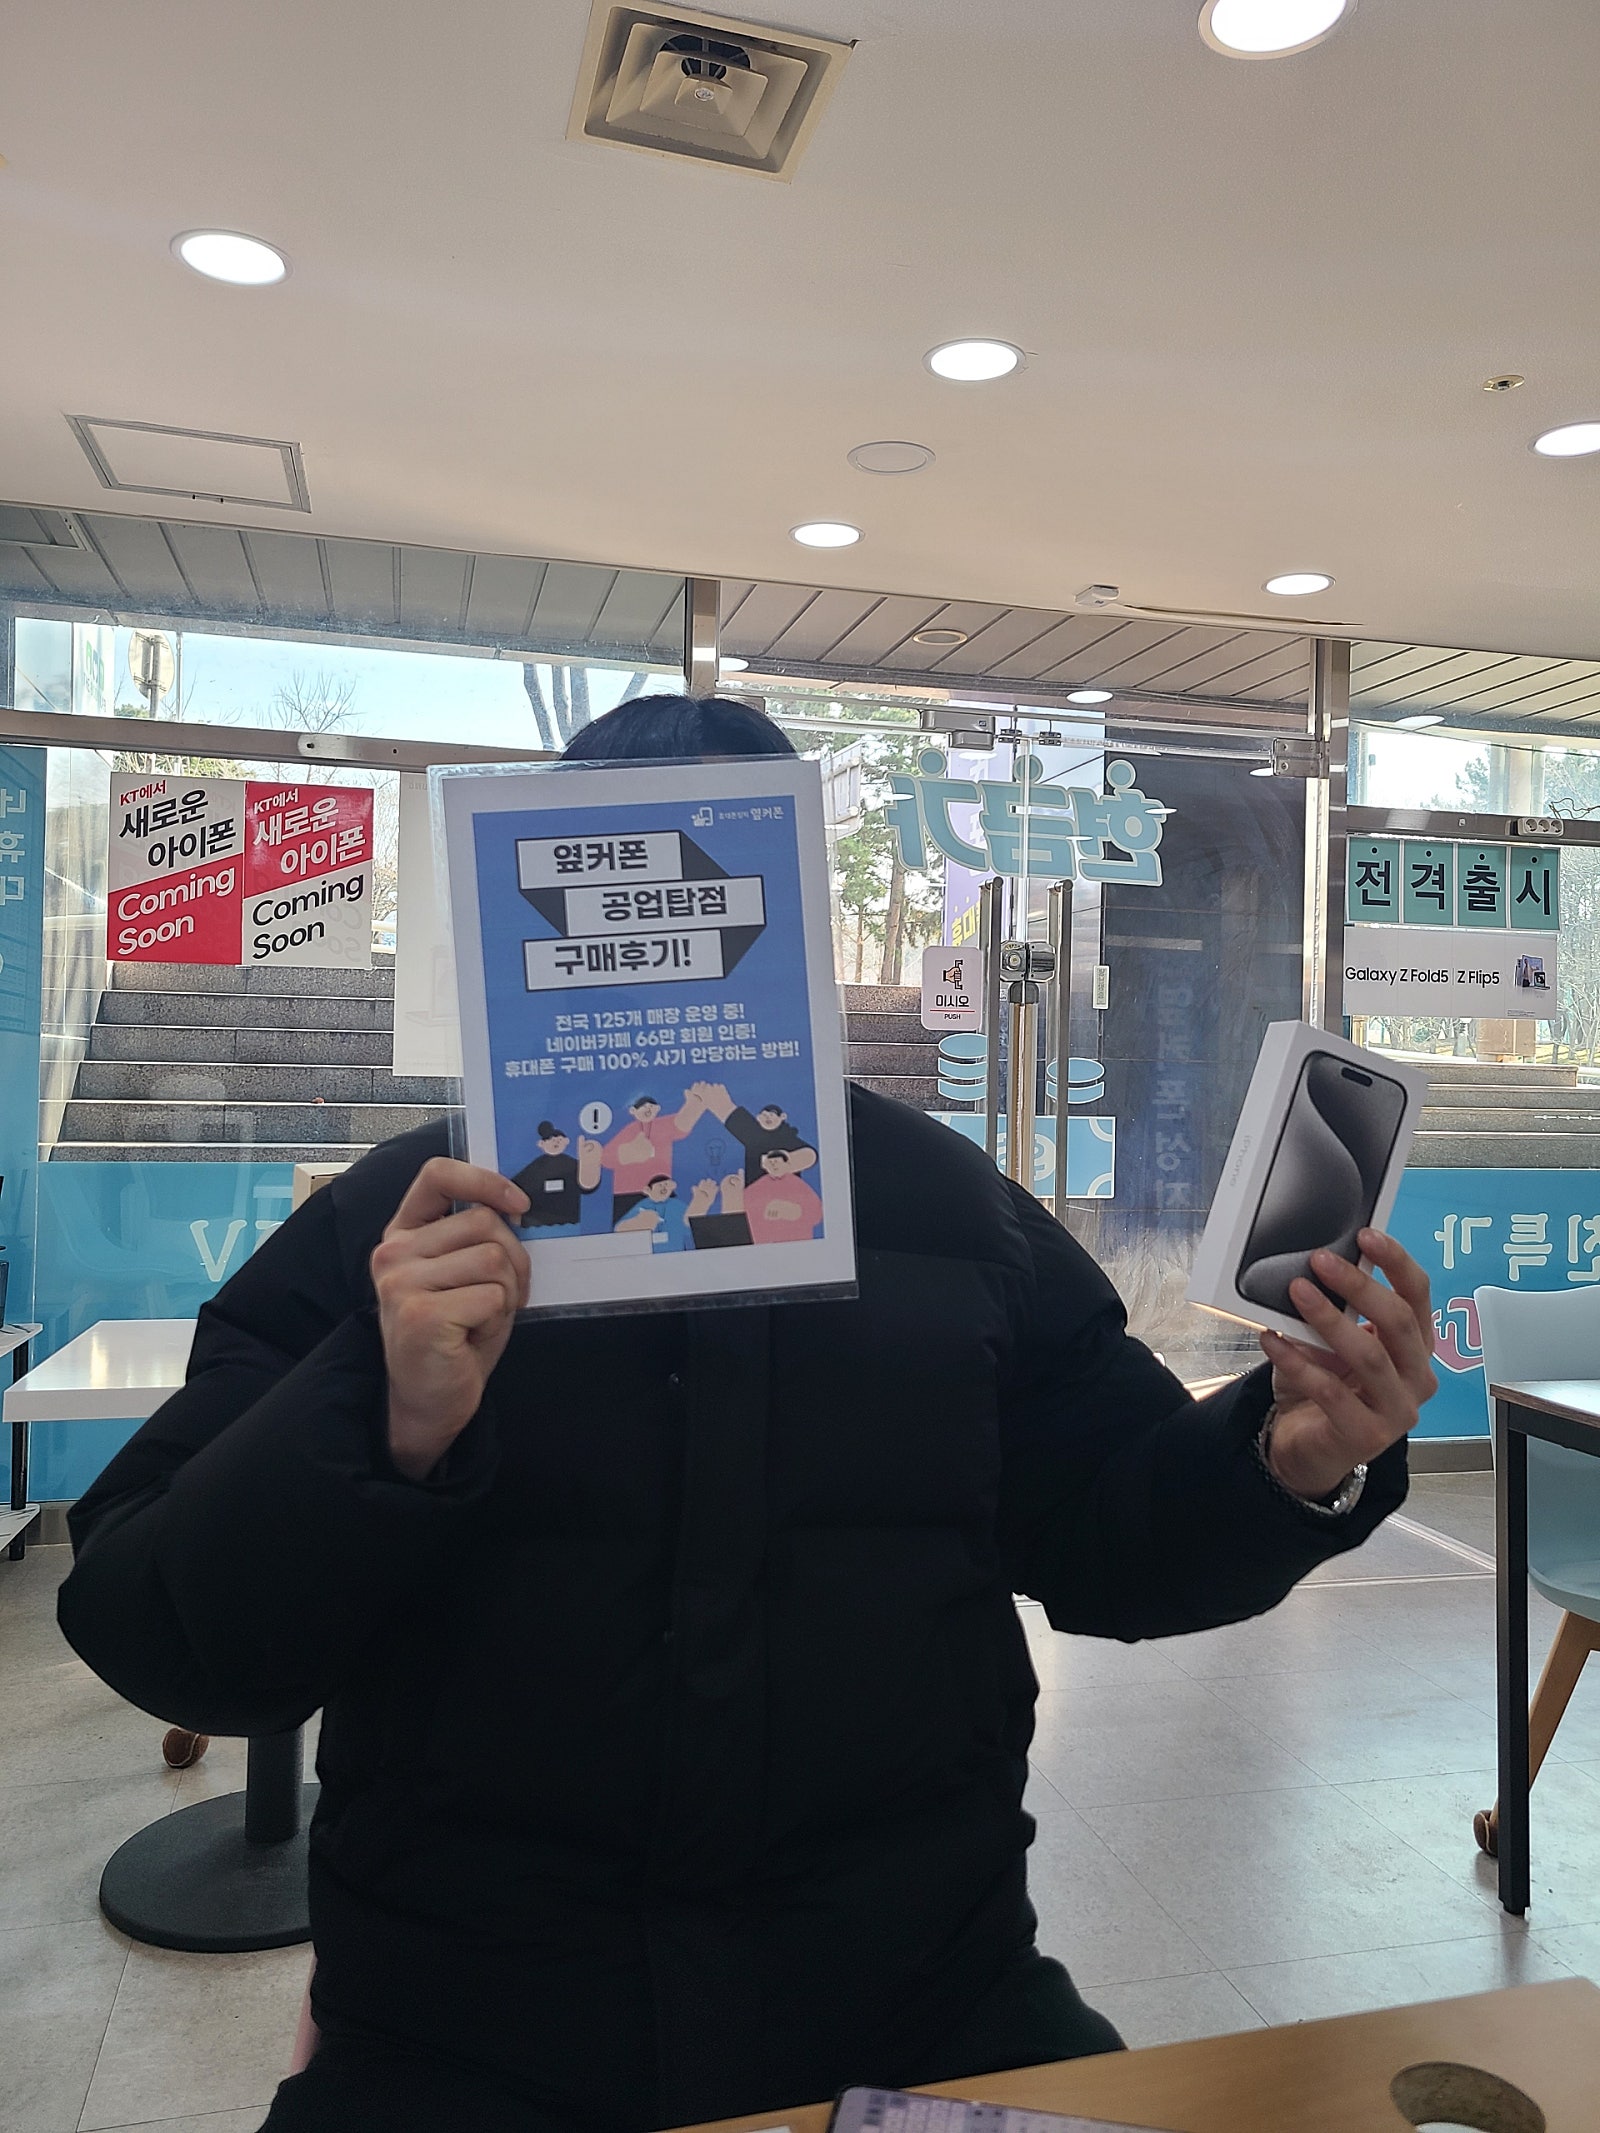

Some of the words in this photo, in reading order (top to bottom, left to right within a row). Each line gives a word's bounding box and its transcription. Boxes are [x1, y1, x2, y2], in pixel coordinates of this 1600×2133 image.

[119, 780, 167, 806] KT에서
[253, 788, 299, 815] KT에서
[118, 789, 209, 840] 새로운
[252, 797, 340, 848] 새로운
[750, 806, 784, 821] 옆커폰
[147, 818, 236, 869] 아이폰
[280, 825, 367, 876] 아이폰
[553, 840, 649, 875] 옆커폰
[117, 866, 236, 922] Coming
[252, 873, 365, 927] Coming
[601, 885, 728, 922] 공업탑점
[1354, 858, 1551, 916] 전격출시
[117, 912, 195, 956] Soon
[252, 918, 326, 960] Soon
[554, 938, 693, 976] 구매후기!
[1345, 967, 1398, 985] Galaxy
[1400, 968, 1408, 982] Z
[1410, 968, 1449, 983] Fold5
[1457, 970, 1466, 984] Z
[1468, 970, 1500, 988] Flip5
[555, 1014, 589, 1031] 전국
[593, 1011, 643, 1029] 125개
[647, 1008, 680, 1026] 매장
[685, 1005, 718, 1022] 운영
[723, 1003, 745, 1021] 중!
[546, 1035, 632, 1054] 네이버카페
[636, 1028, 676, 1047] 66만
[680, 1025, 714, 1044] 회원
[718, 1023, 757, 1041] 인증!
[505, 1058, 556, 1079] 휴대폰
[560, 1055, 595, 1075] 구매
[599, 1050, 649, 1071] 100%
[653, 1048, 687, 1066] 사기
[690, 1044, 757, 1065] 안당하는
[761, 1040, 800, 1059] 방법!
